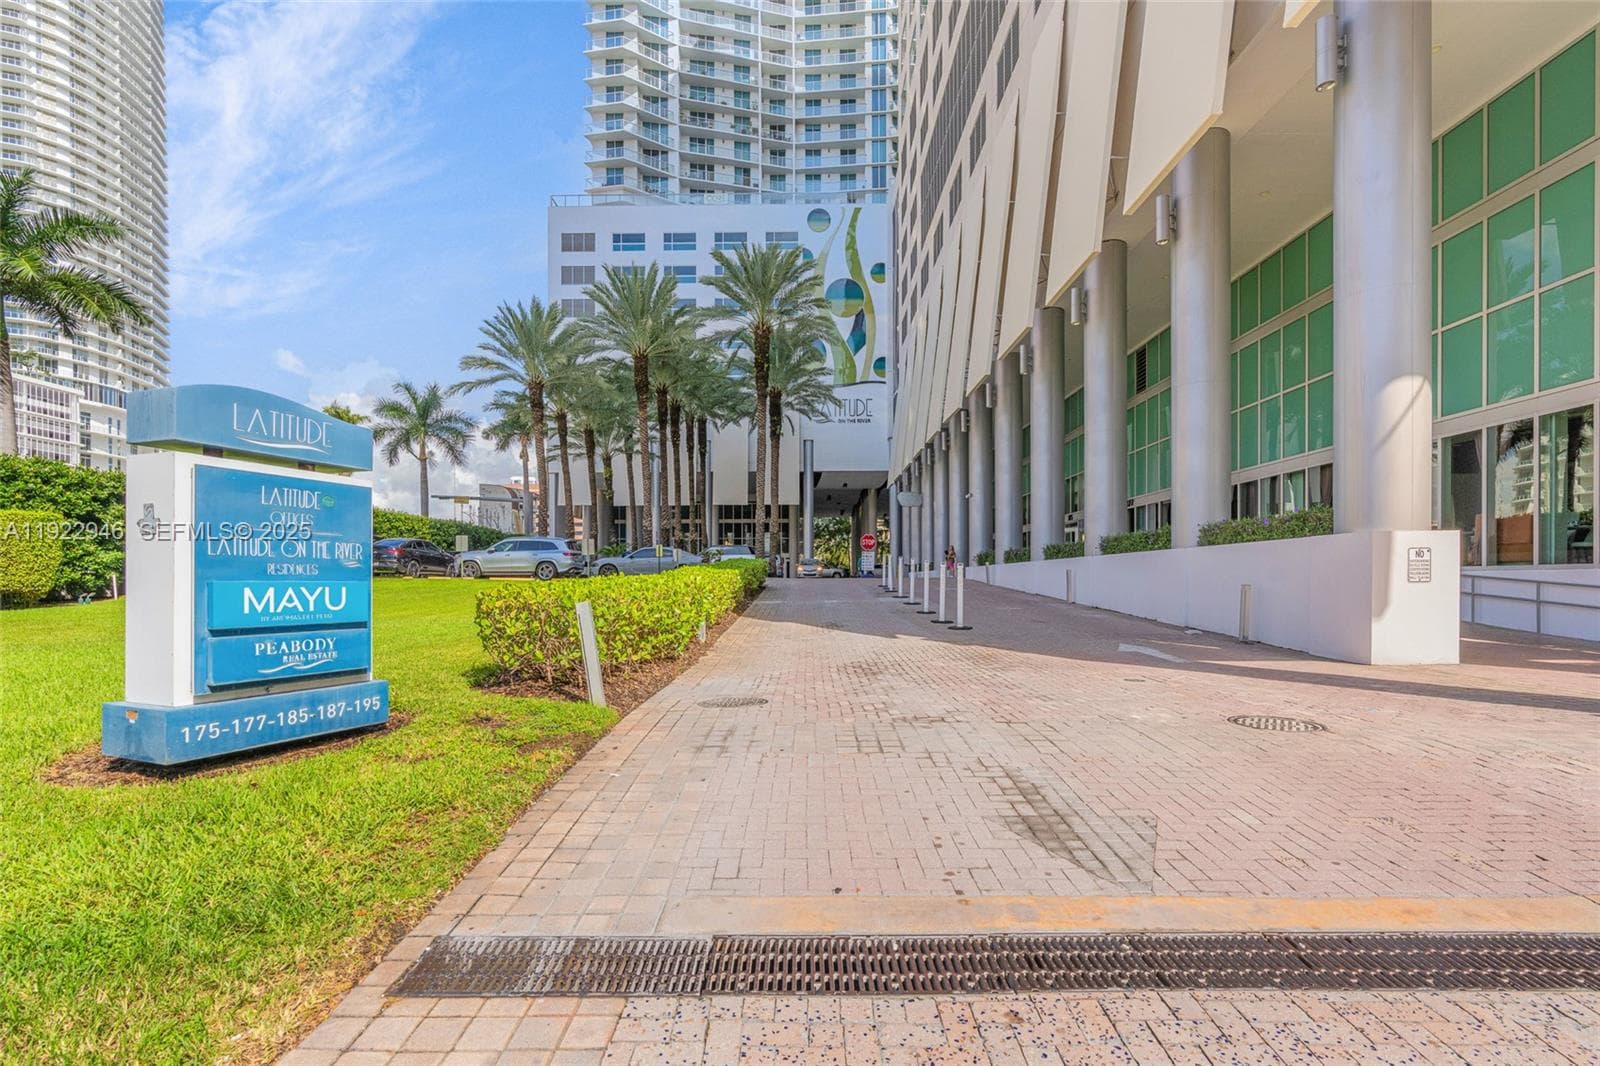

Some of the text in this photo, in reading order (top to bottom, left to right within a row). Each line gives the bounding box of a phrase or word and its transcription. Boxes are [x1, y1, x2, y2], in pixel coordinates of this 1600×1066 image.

[233, 402, 333, 448] LATITUDE
[261, 485, 321, 510] LATITUDE
[207, 538, 363, 560] LATITUDE ON THE RIVER
[1415, 550, 1425, 558] NO
[267, 563, 319, 576] RESIDENCES
[243, 586, 347, 614] MAYU
[254, 637, 337, 656] PEABODY
[283, 651, 338, 664] REAL ESTATE
[181, 696, 381, 744] 175-177-185-187-195
